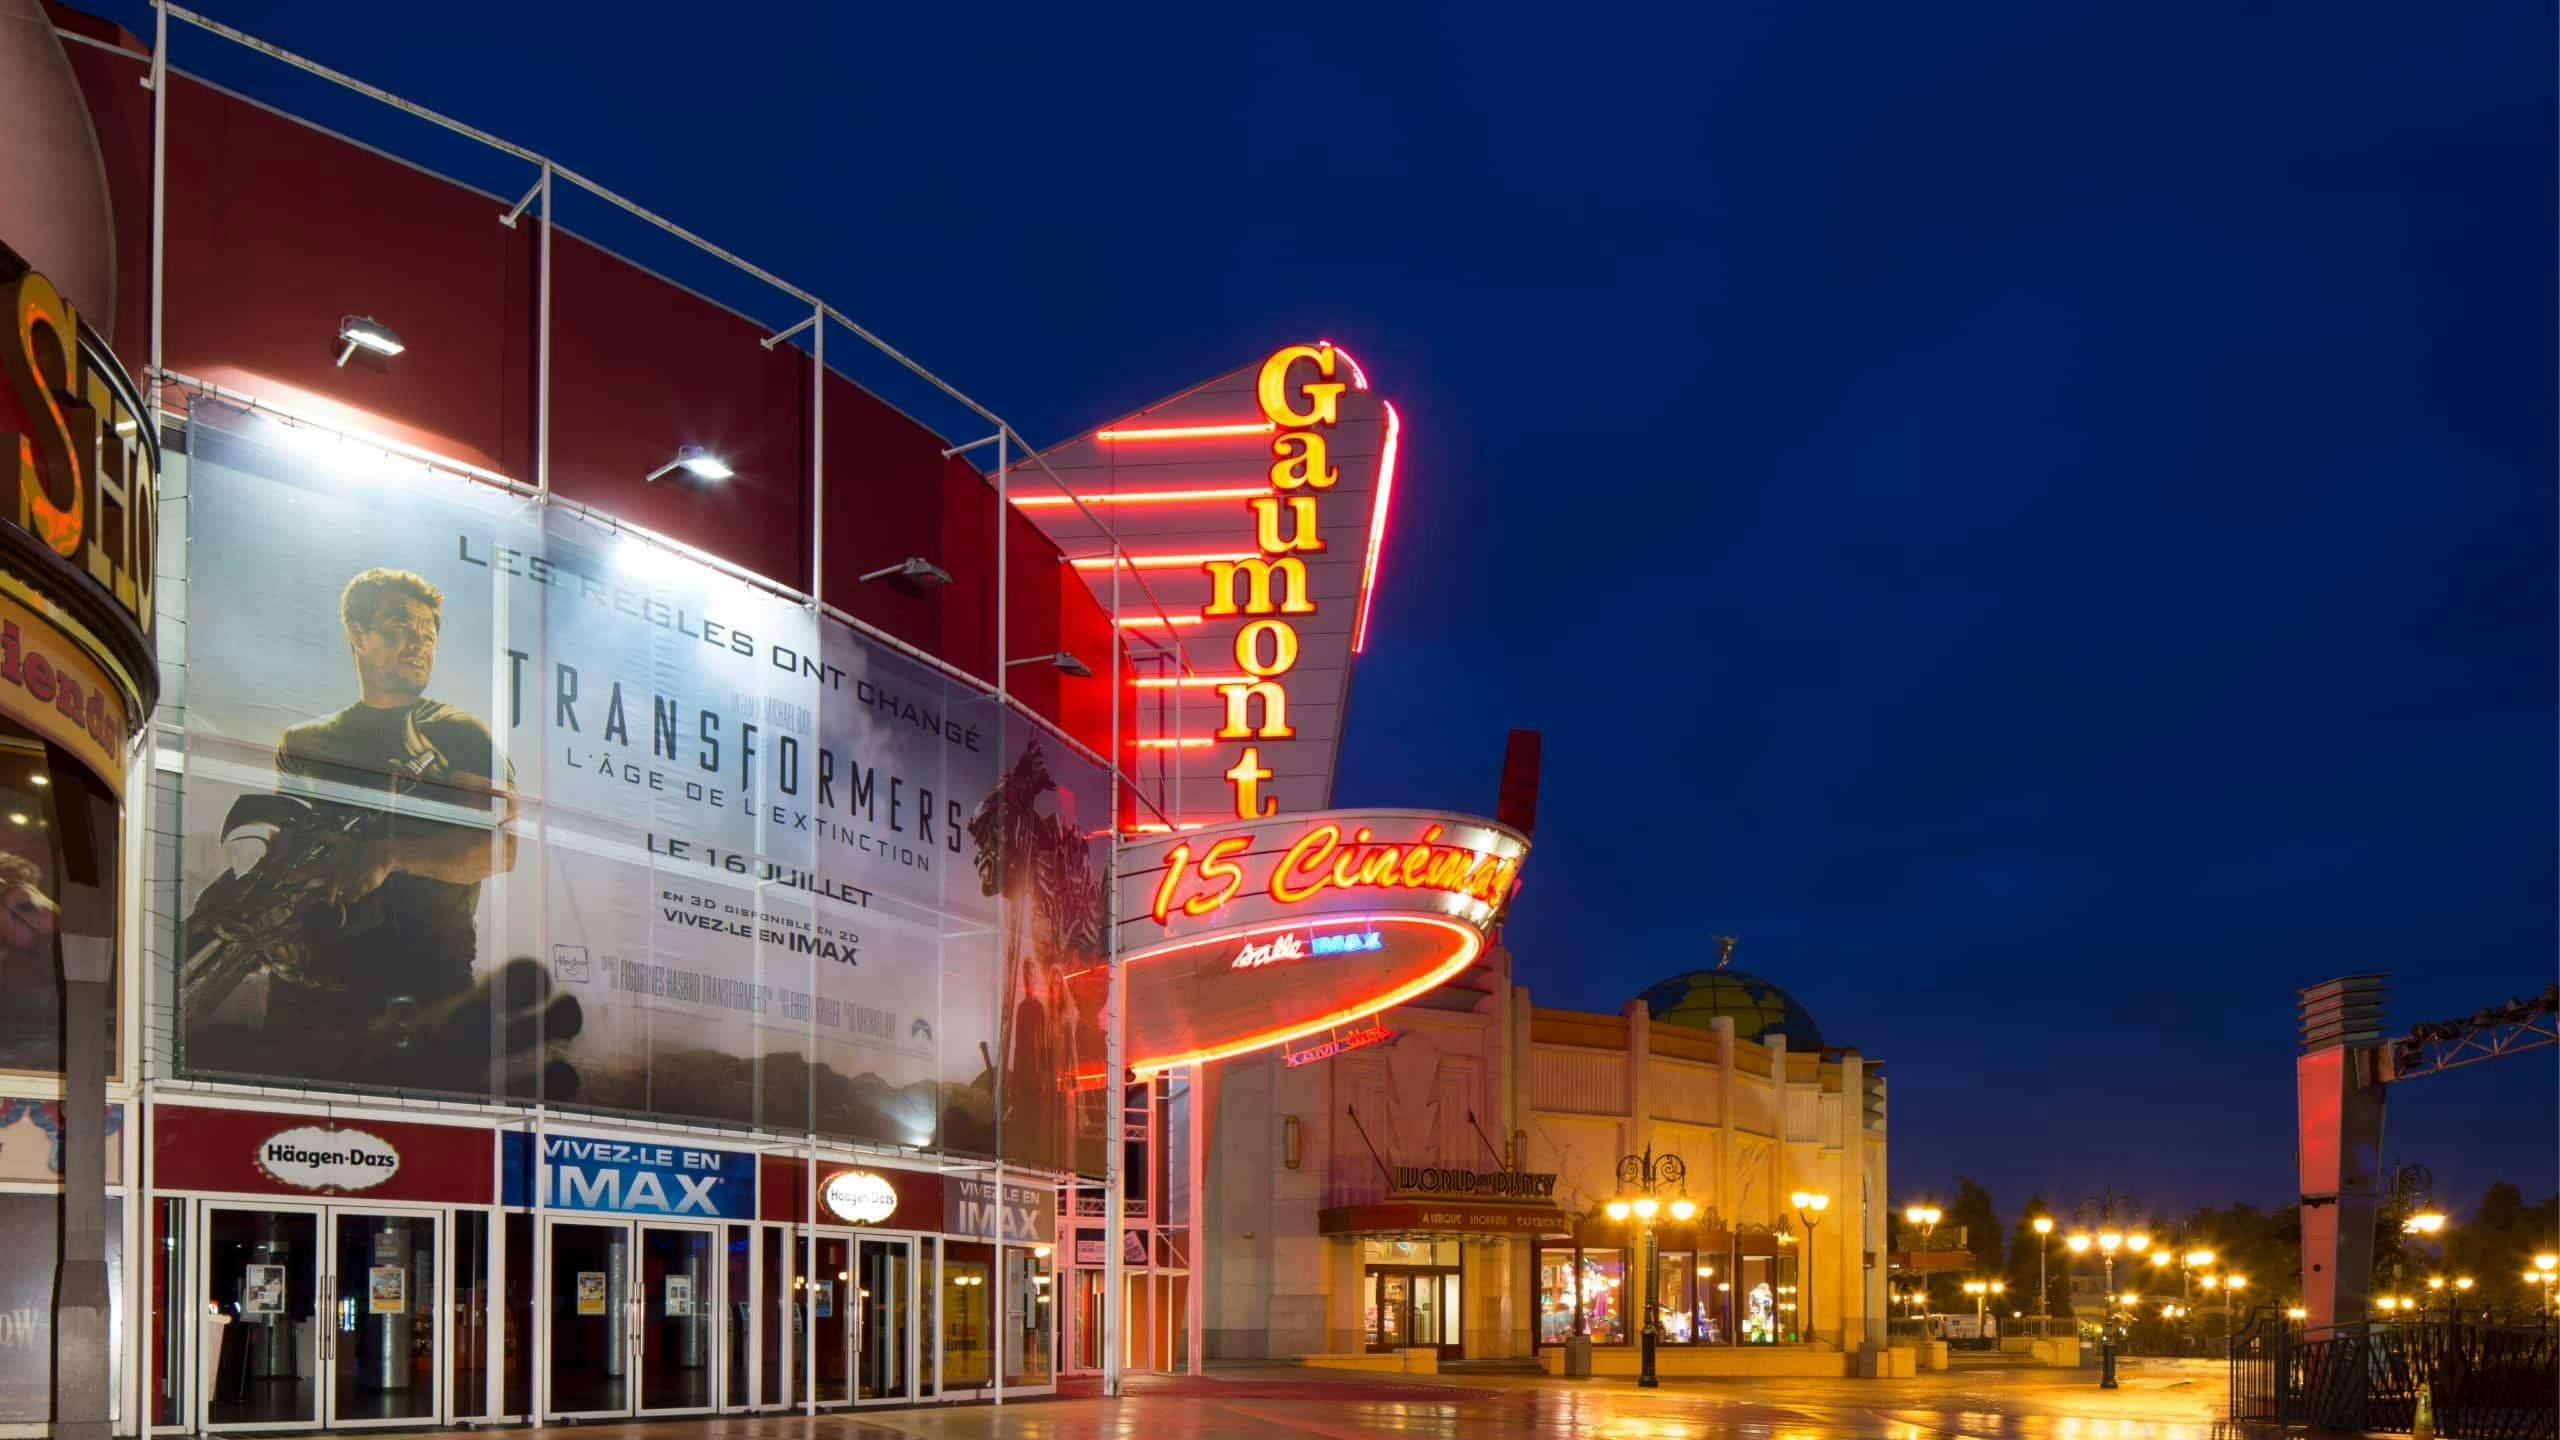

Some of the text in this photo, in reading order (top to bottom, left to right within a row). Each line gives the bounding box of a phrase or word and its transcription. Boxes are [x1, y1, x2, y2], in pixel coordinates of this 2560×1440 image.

[1203, 344, 1346, 820] Gaumont
[460, 536, 556, 586] LES
[772, 645, 846, 690] ONT
[857, 680, 981, 752] CHANGÉ
[504, 648, 961, 853] TRANSFORMERS
[686, 782, 725, 808] DE
[647, 832, 873, 908] LE 16 JUILLET
[1153, 834, 1255, 926] 15
[662, 890, 859, 944] EN 3D DISPONIBLE EN 2D
[663, 908, 860, 967] VIVEZ-LE EN IMAX
[1231, 931, 1382, 968] salle IMAX
[268, 1144, 395, 1169] Häagen-Dazs
[544, 1139, 721, 1171] VIVEZ-LE EN
[544, 1164, 721, 1216] IMAX
[960, 1181, 1040, 1204] VIVEZLE EN
[1399, 1167, 1476, 1192] WORLD
[1497, 1170, 1557, 1197] DISNEY
[960, 1201, 1039, 1240] IMAX
